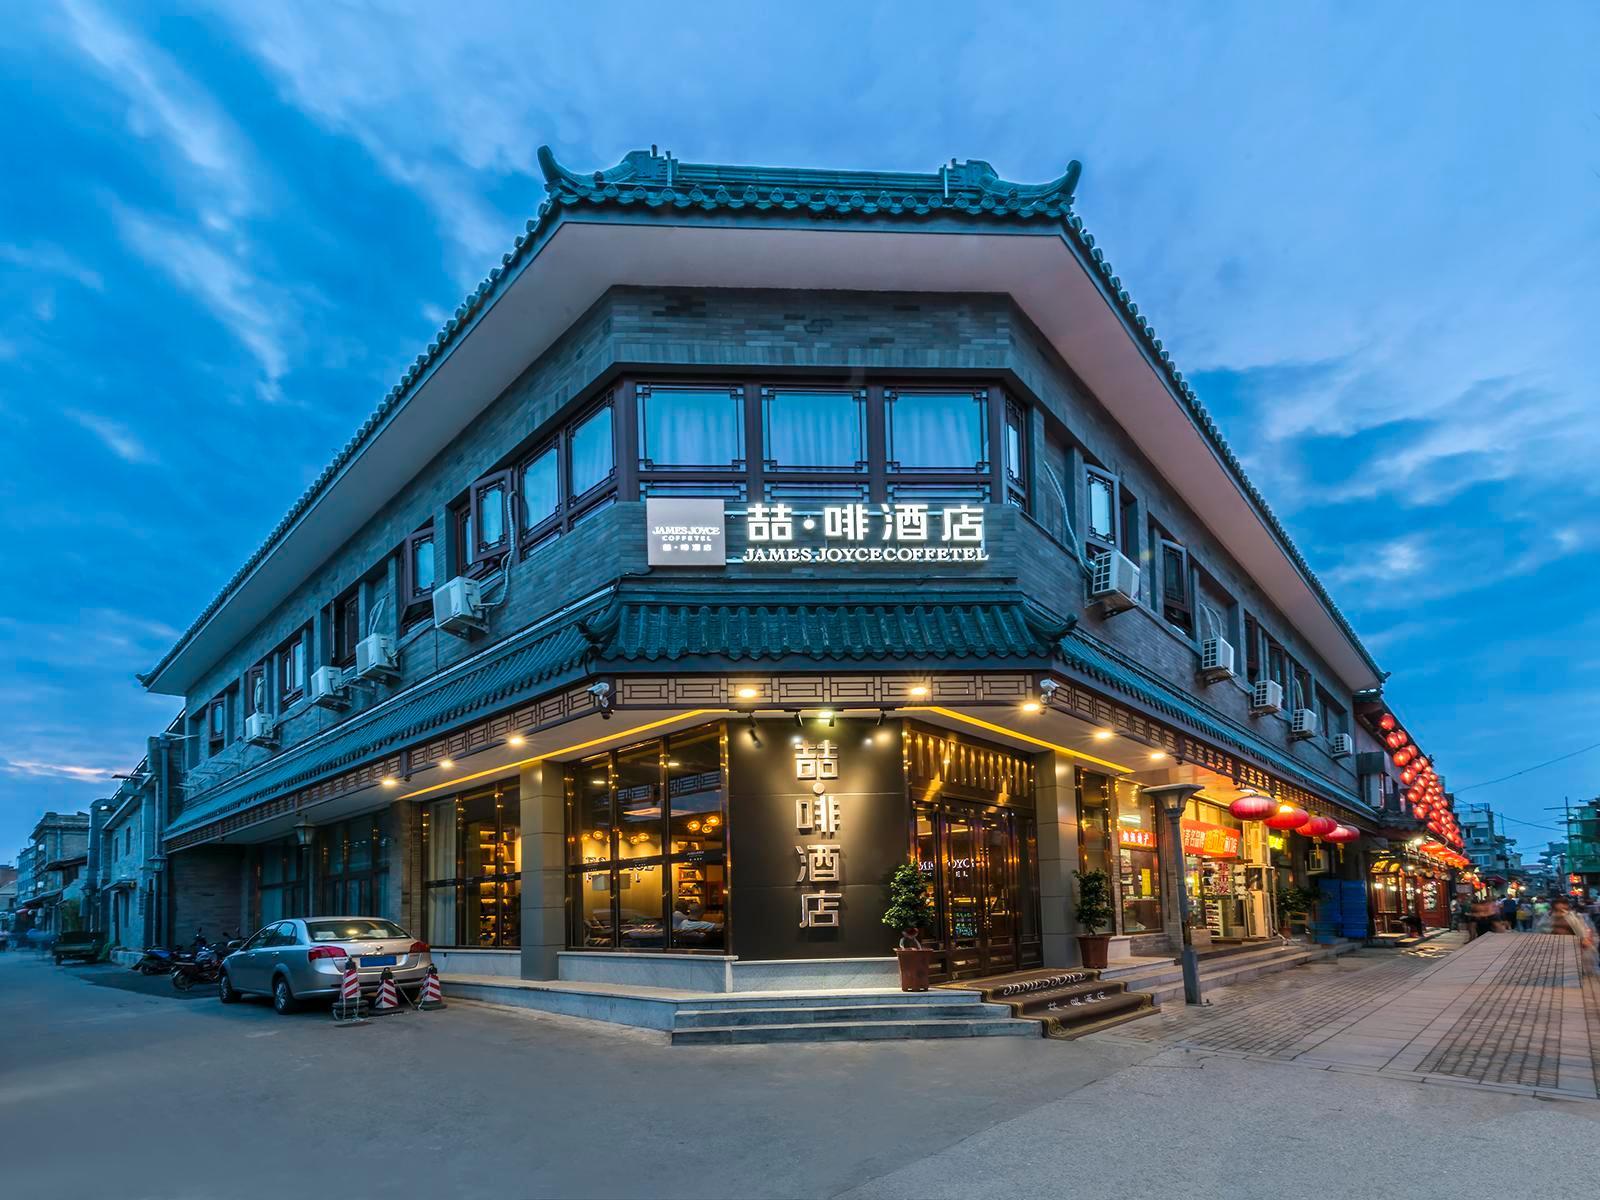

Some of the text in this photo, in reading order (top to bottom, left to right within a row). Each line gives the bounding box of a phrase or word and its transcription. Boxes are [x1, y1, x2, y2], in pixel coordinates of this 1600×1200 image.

[747, 503, 985, 541] 喆·啡酒店
[743, 548, 812, 562] JAMES
